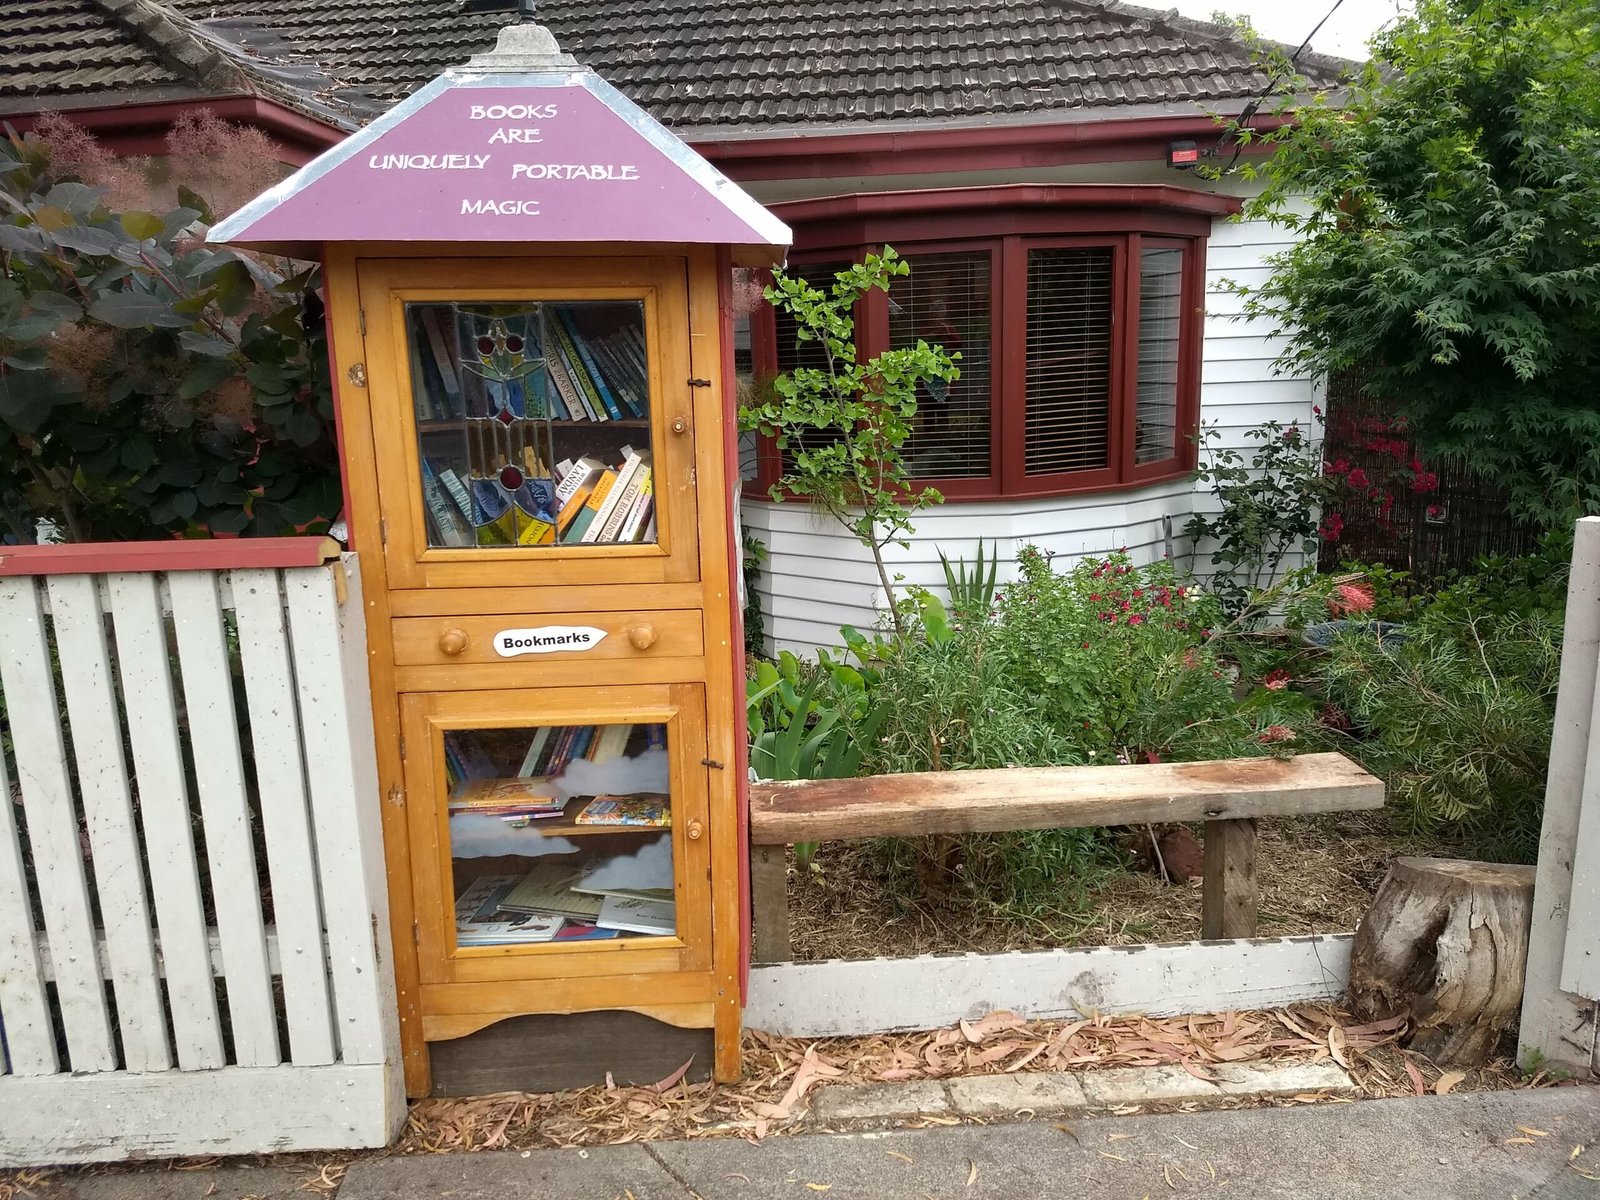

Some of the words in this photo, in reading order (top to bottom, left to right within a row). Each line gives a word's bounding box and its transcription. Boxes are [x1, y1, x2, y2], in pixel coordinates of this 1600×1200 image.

[469, 104, 558, 120] BOOKS
[488, 127, 544, 144] ARE
[368, 154, 491, 170] UNIQUELY
[511, 163, 640, 180] PORTABLE
[460, 199, 540, 216] MAGIC
[558, 464, 584, 496] LANDAY
[567, 472, 586, 496] WILLIAM
[624, 483, 639, 502] TOM
[605, 501, 628, 536] ROBBINS
[503, 632, 590, 649] Bookmarks
